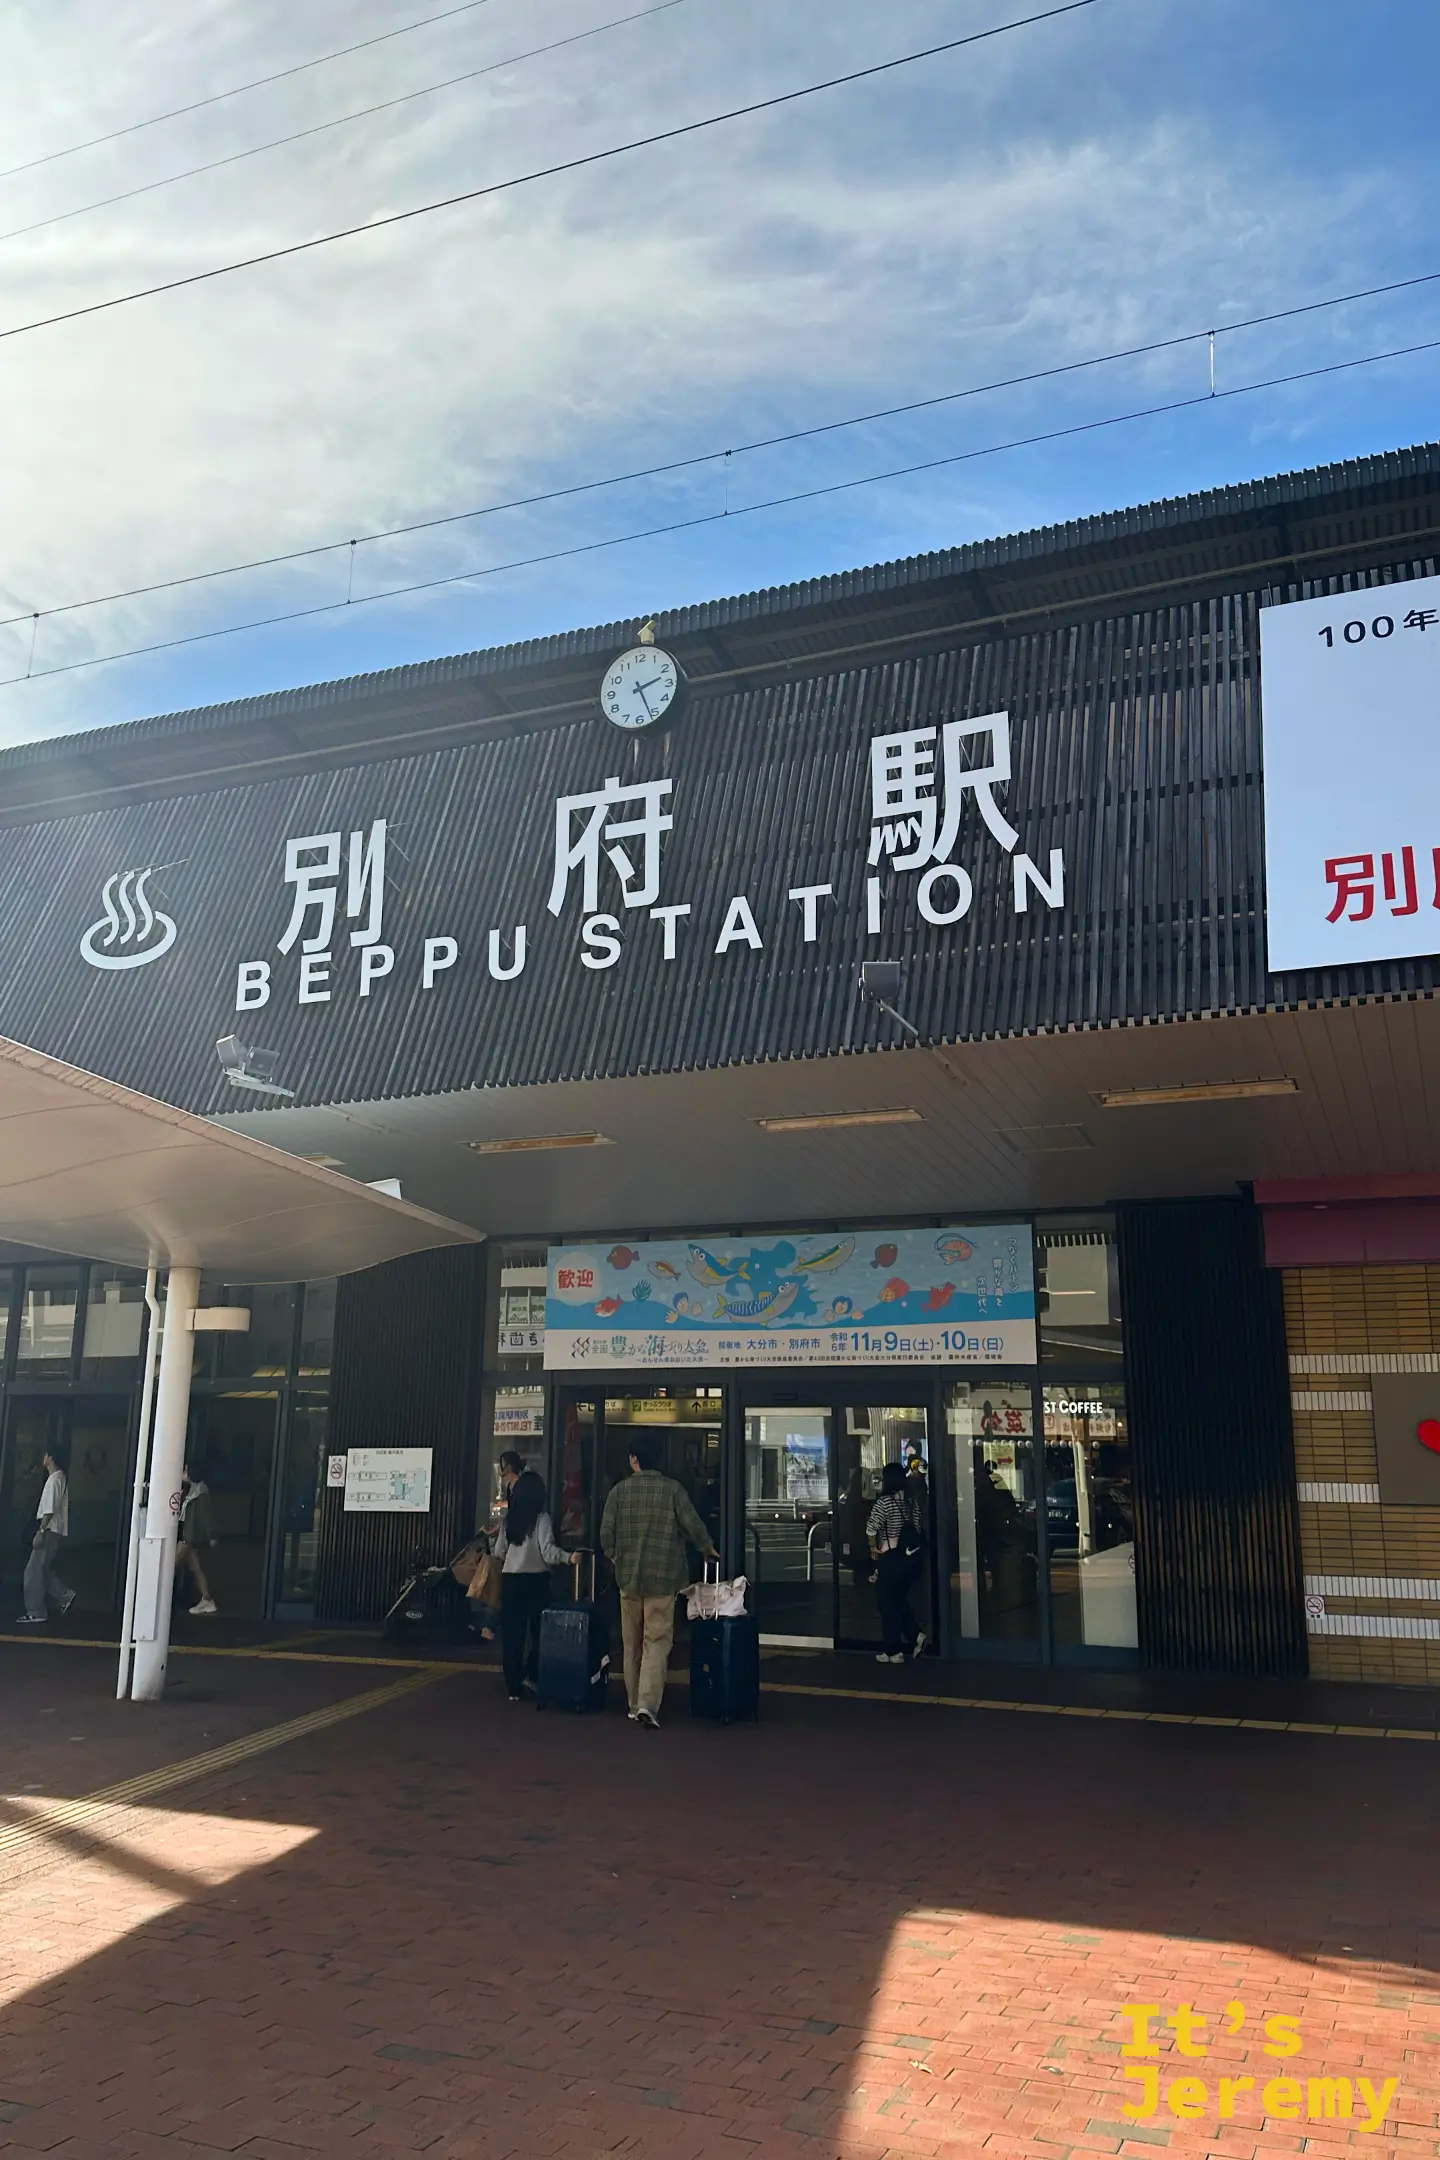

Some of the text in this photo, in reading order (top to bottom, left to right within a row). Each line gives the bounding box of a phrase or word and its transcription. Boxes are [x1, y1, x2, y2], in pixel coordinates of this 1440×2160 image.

[635, 654, 646, 664] 12
[652, 654, 657, 664] 1
[620, 662, 630, 672] 11
[660, 663, 670, 673] 2
[611, 676, 622, 685] 10
[664, 678, 674, 688] 3
[606, 690, 616, 700] 9
[660, 693, 670, 702] 4
[610, 704, 620, 713] 8
[651, 707, 659, 717] 5
[621, 714, 630, 723] 7
[635, 715, 645, 725] 6
[236, 848, 1065, 1011] BEPPU STATION
[557, 1268, 594, 1290] 歓迎
[829, 1332, 848, 1342] 令和
[831, 1342, 848, 1352] 6年
[1059, 1400, 1103, 1414] COFFEE
